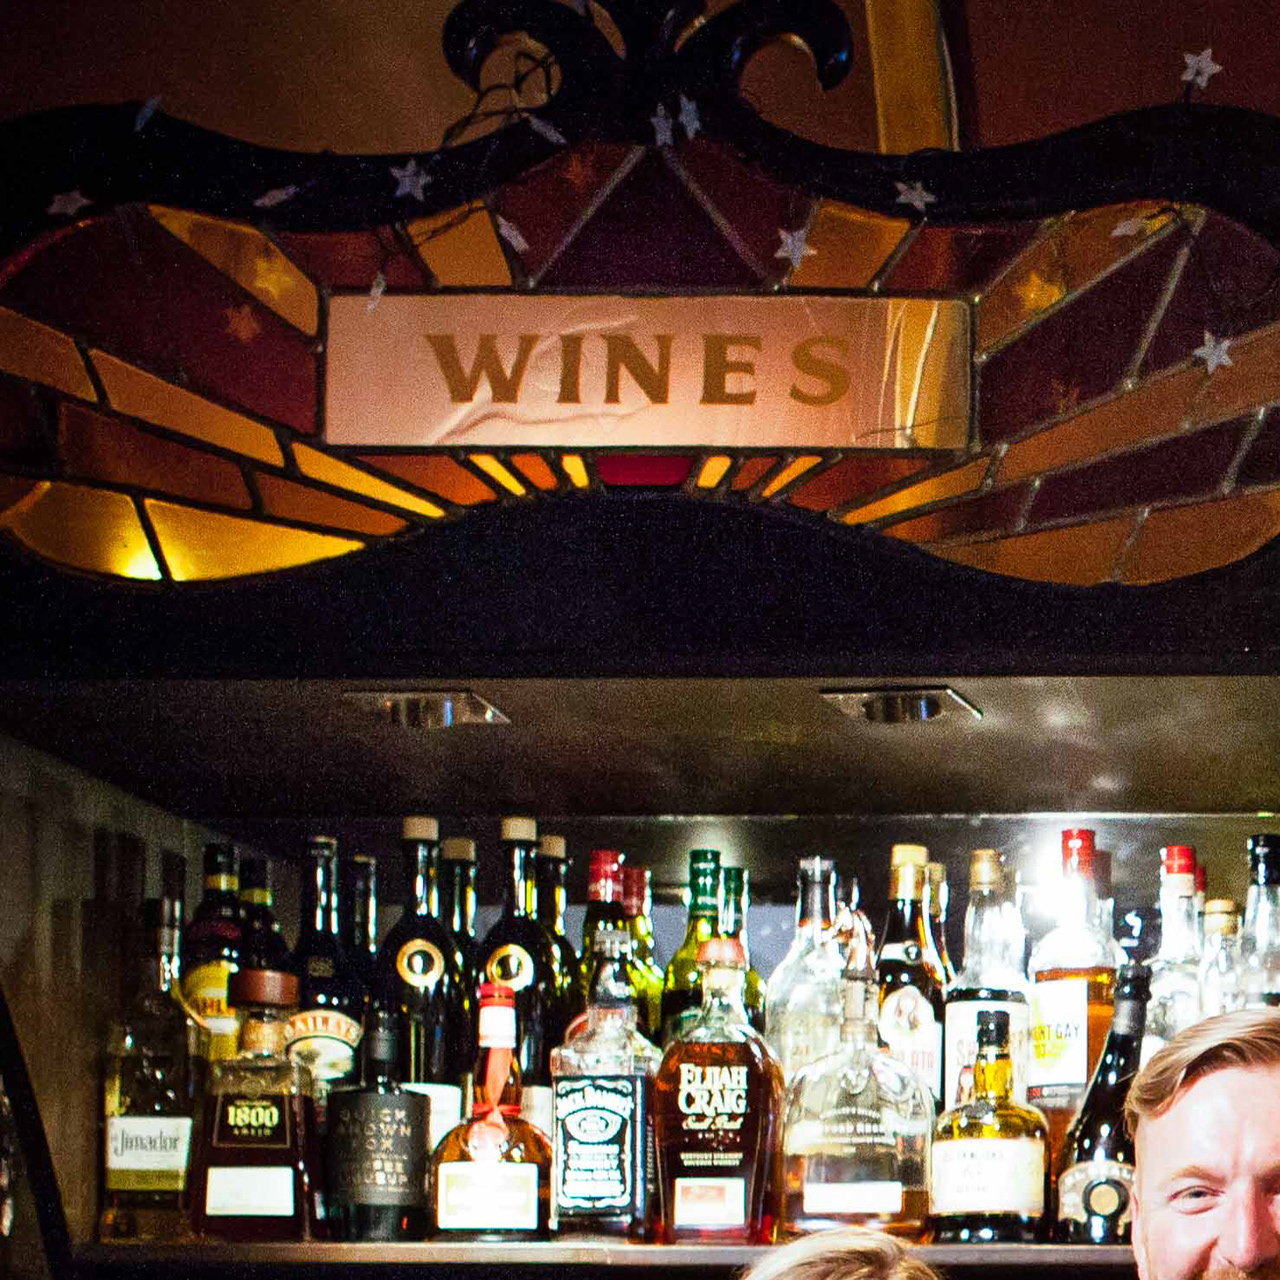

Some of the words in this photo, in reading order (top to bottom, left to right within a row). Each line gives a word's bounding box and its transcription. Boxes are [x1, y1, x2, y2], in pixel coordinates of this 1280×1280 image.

[423, 334, 850, 405] WINES
[284, 1015, 361, 1040] BAILEYS
[679, 1063, 748, 1090] ELIJAH
[227, 1104, 279, 1127] 1800
[678, 1088, 747, 1116] CRAIG
